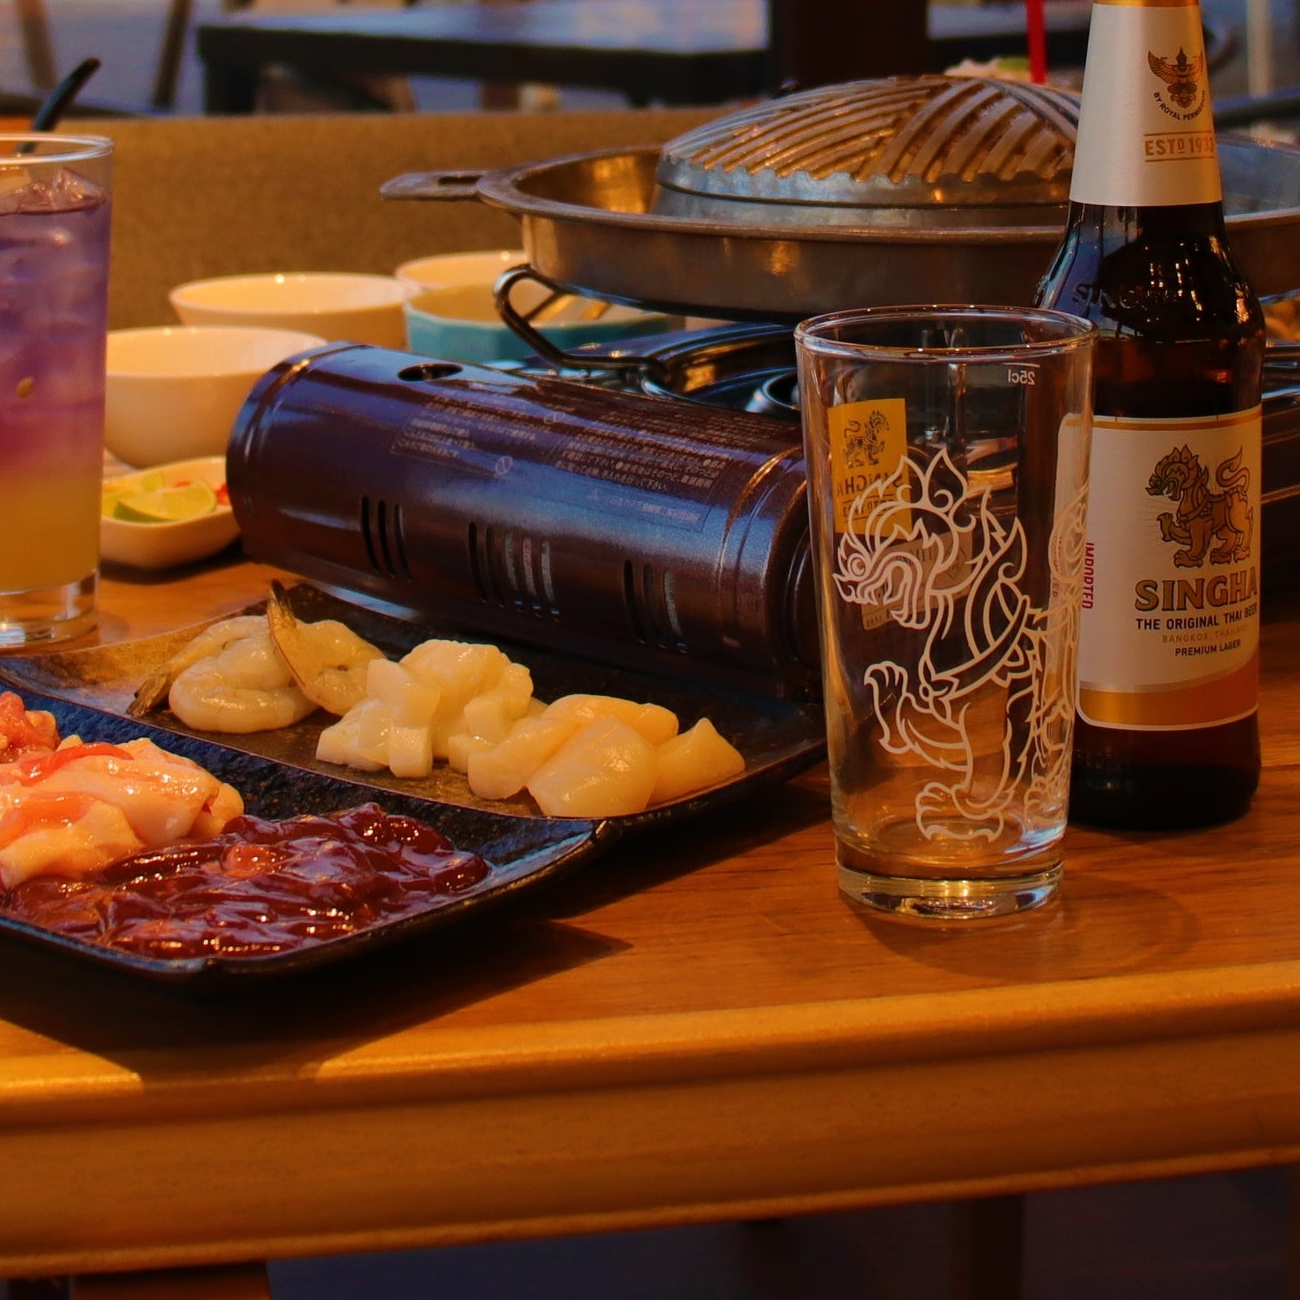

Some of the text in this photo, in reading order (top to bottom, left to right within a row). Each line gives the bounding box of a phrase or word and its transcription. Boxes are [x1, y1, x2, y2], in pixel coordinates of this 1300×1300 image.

[1159, 103, 1181, 121] ROYAL
[1134, 566, 1258, 612] SINGHA
[1135, 618, 1160, 630] THE
[1166, 616, 1220, 630] ORIGINAL
[1224, 611, 1242, 625] THAI
[1175, 639, 1241, 657] PREMIUM LAGER
